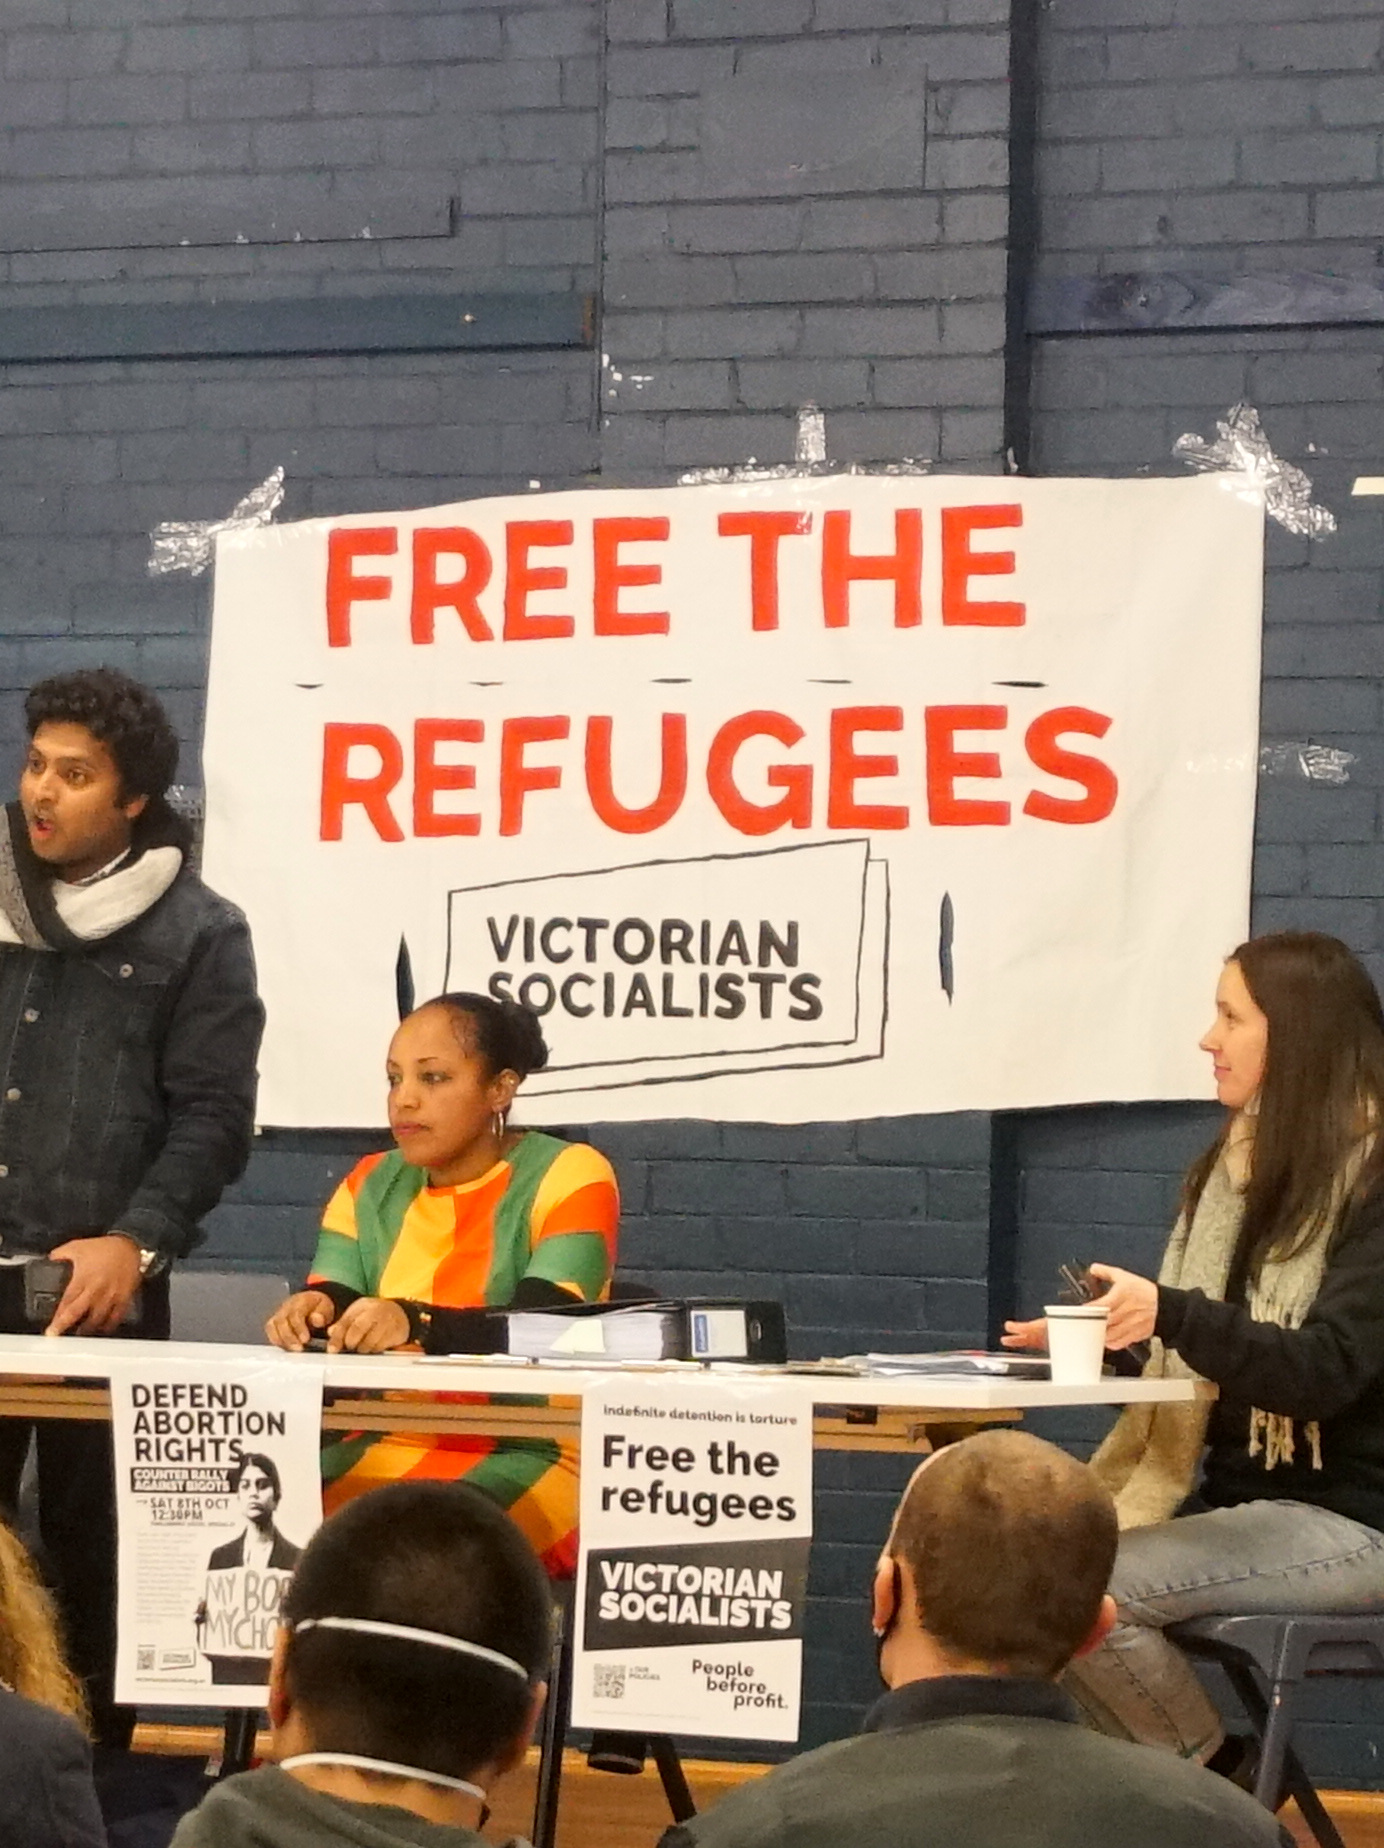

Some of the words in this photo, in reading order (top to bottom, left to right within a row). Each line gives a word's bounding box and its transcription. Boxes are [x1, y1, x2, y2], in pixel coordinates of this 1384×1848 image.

[326, 516, 671, 648] FREE
[717, 503, 1027, 632] THE
[319, 704, 1119, 843] REFUGEES
[486, 914, 800, 967] VICTORIAN
[487, 970, 824, 1022] SOCIALISTS
[131, 1384, 248, 1408] DEFEND
[133, 1411, 285, 1436] ABORTION
[603, 1404, 666, 1418] Indefinite
[669, 1407, 733, 1422] detention
[735, 1411, 746, 1423] is
[749, 1413, 798, 1425] torture
[134, 1438, 244, 1462] RIGHTS
[602, 1434, 696, 1473] Free
[708, 1440, 780, 1477] the
[134, 1469, 190, 1481] COUNTER
[191, 1469, 229, 1481] RALLY
[134, 1480, 185, 1492] AGAINST
[186, 1480, 230, 1492] BIGOTS
[150, 1498, 174, 1509] SAT
[204, 1499, 230, 1510] OCT
[152, 1509, 203, 1521] 12:30PM
[601, 1480, 797, 1527] refugees
[205, 1573, 236, 1605] MY
[600, 1560, 784, 1599] VICTORIAN
[598, 1591, 792, 1630] SOCIALISTS
[204, 1607, 240, 1650] MY
[692, 1659, 755, 1679] People
[706, 1677, 767, 1694] before
[733, 1694, 789, 1711] profit.
